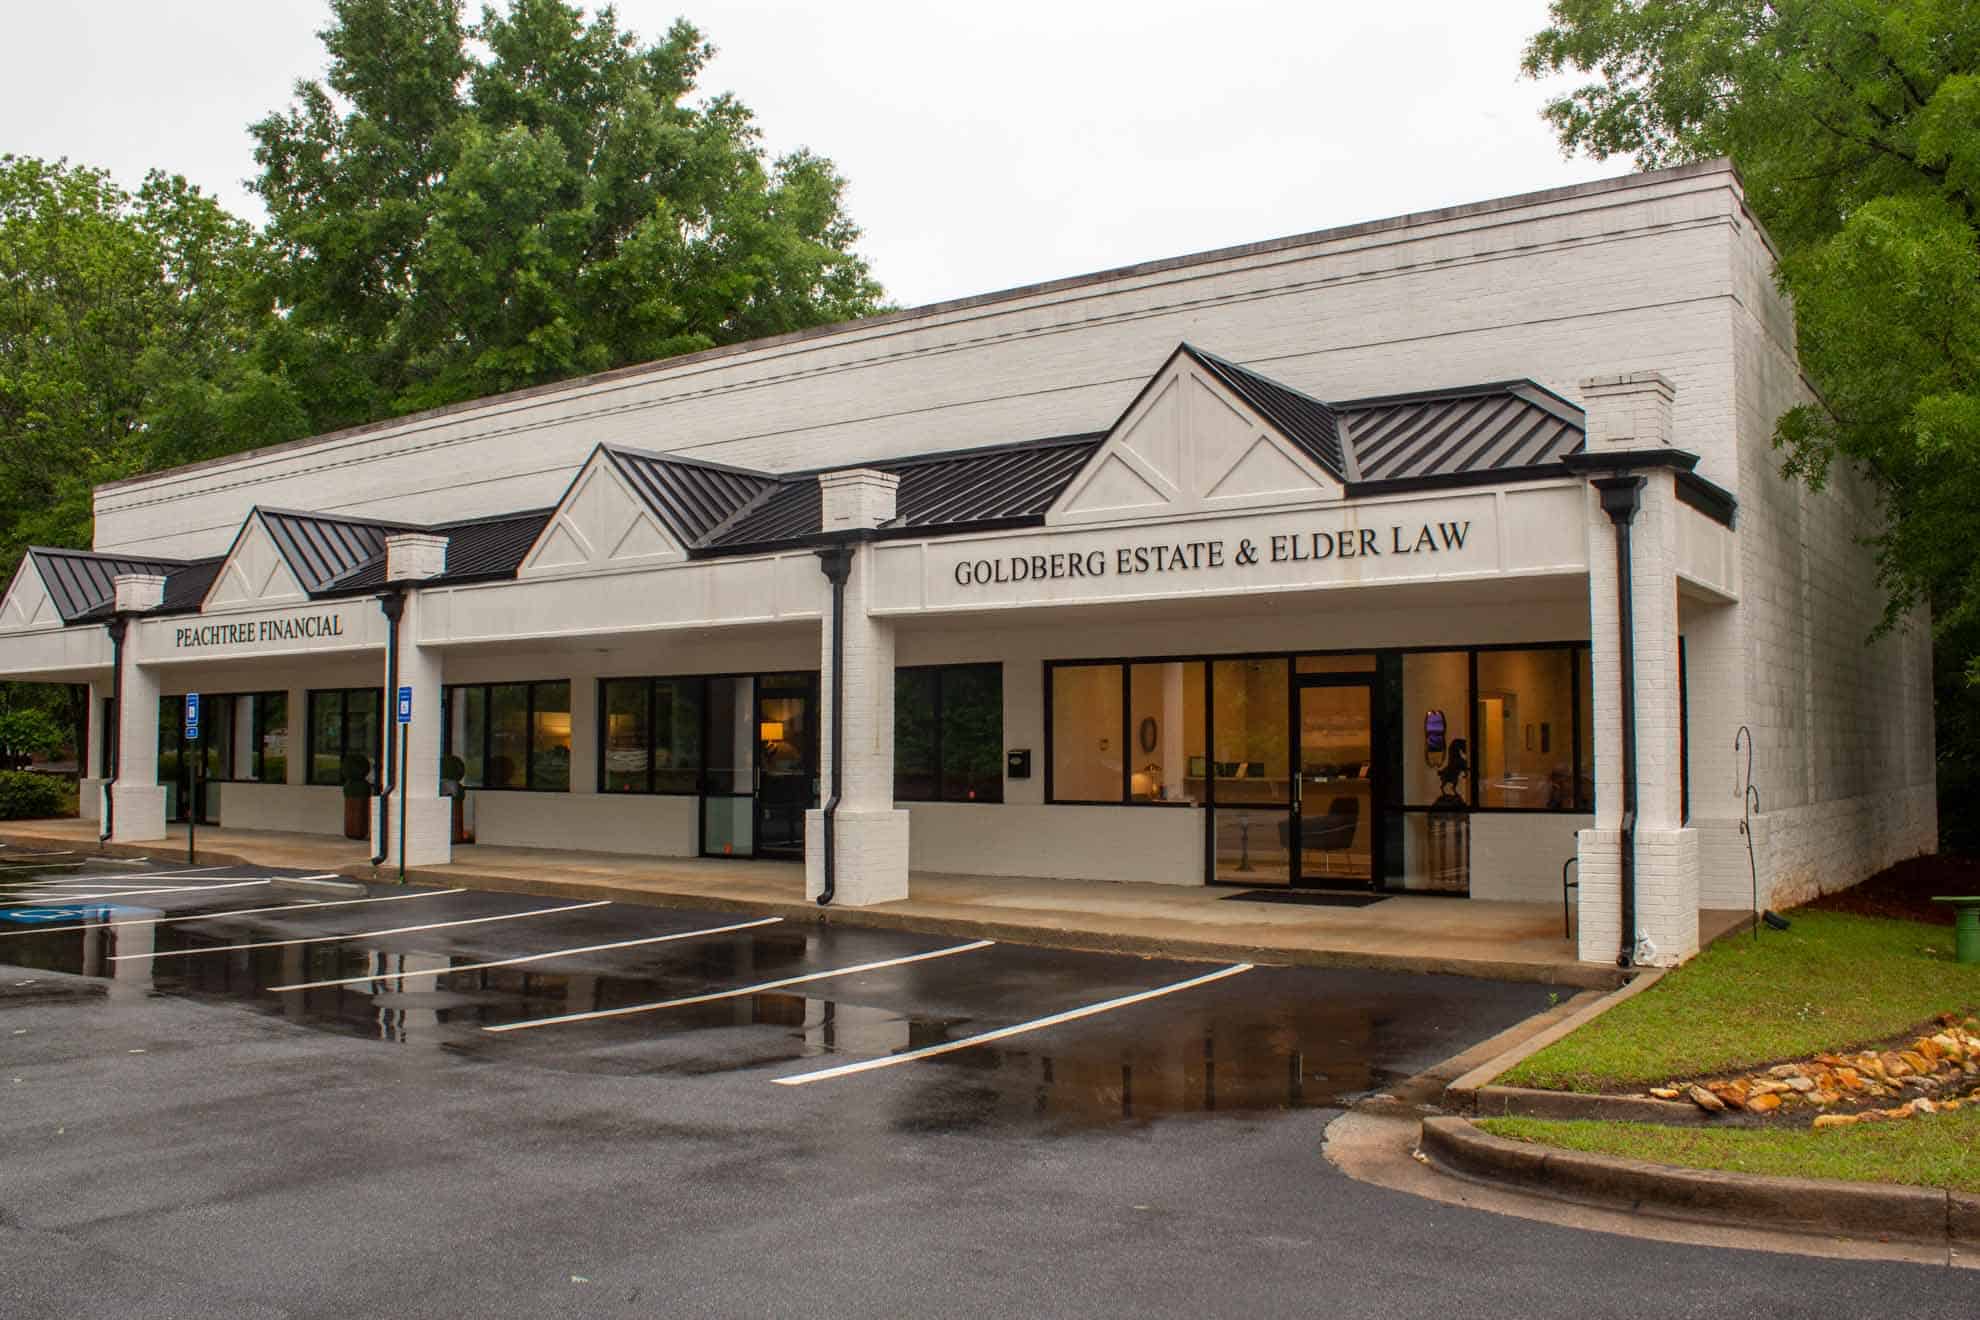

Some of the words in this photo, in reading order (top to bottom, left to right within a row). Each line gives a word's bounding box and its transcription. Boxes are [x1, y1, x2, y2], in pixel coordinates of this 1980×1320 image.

[954, 550, 1105, 586] GOLDBERG
[1116, 541, 1225, 576] ESTATE
[1234, 537, 1259, 567] &
[1270, 528, 1381, 563] ELDER
[1391, 520, 1471, 555] LAW
[176, 621, 256, 648] PEACHTREE
[259, 613, 344, 641] FINANCIAL
